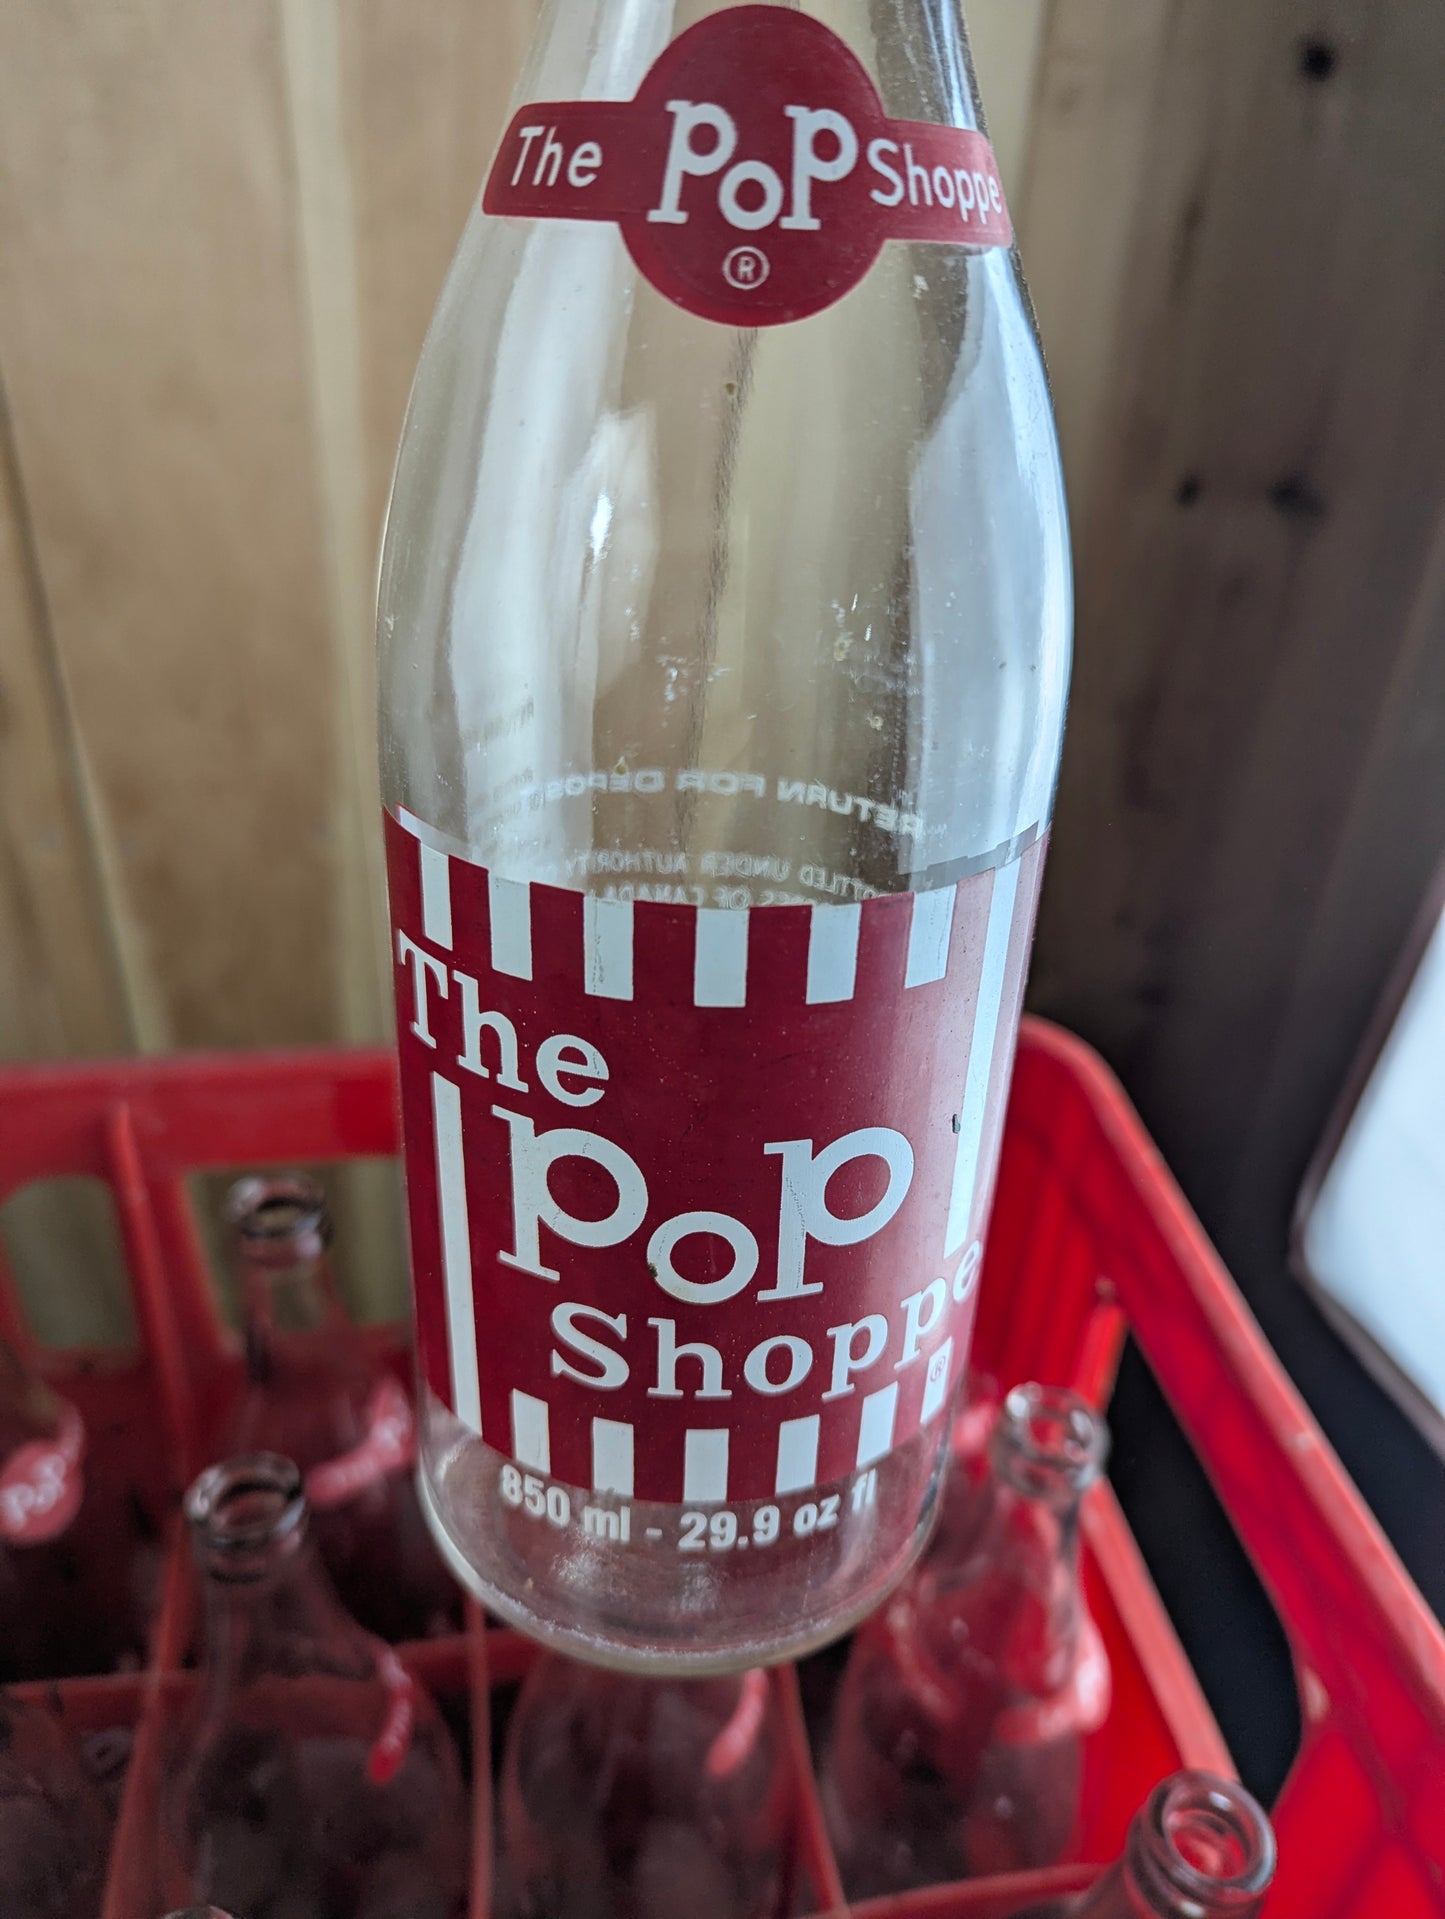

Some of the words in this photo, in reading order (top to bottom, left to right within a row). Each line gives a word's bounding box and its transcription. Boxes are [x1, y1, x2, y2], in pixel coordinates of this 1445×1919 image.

[510, 126, 602, 187] The
[866, 138, 1002, 225] Shoppe
[400, 928, 610, 1108] The
[549, 1239, 981, 1400] Shoppe
[500, 1463, 571, 1527] 850
[582, 1505, 631, 1542] ml
[677, 1504, 781, 1552] 29.9
[793, 1493, 840, 1538] oz
[852, 1469, 878, 1513] fl
